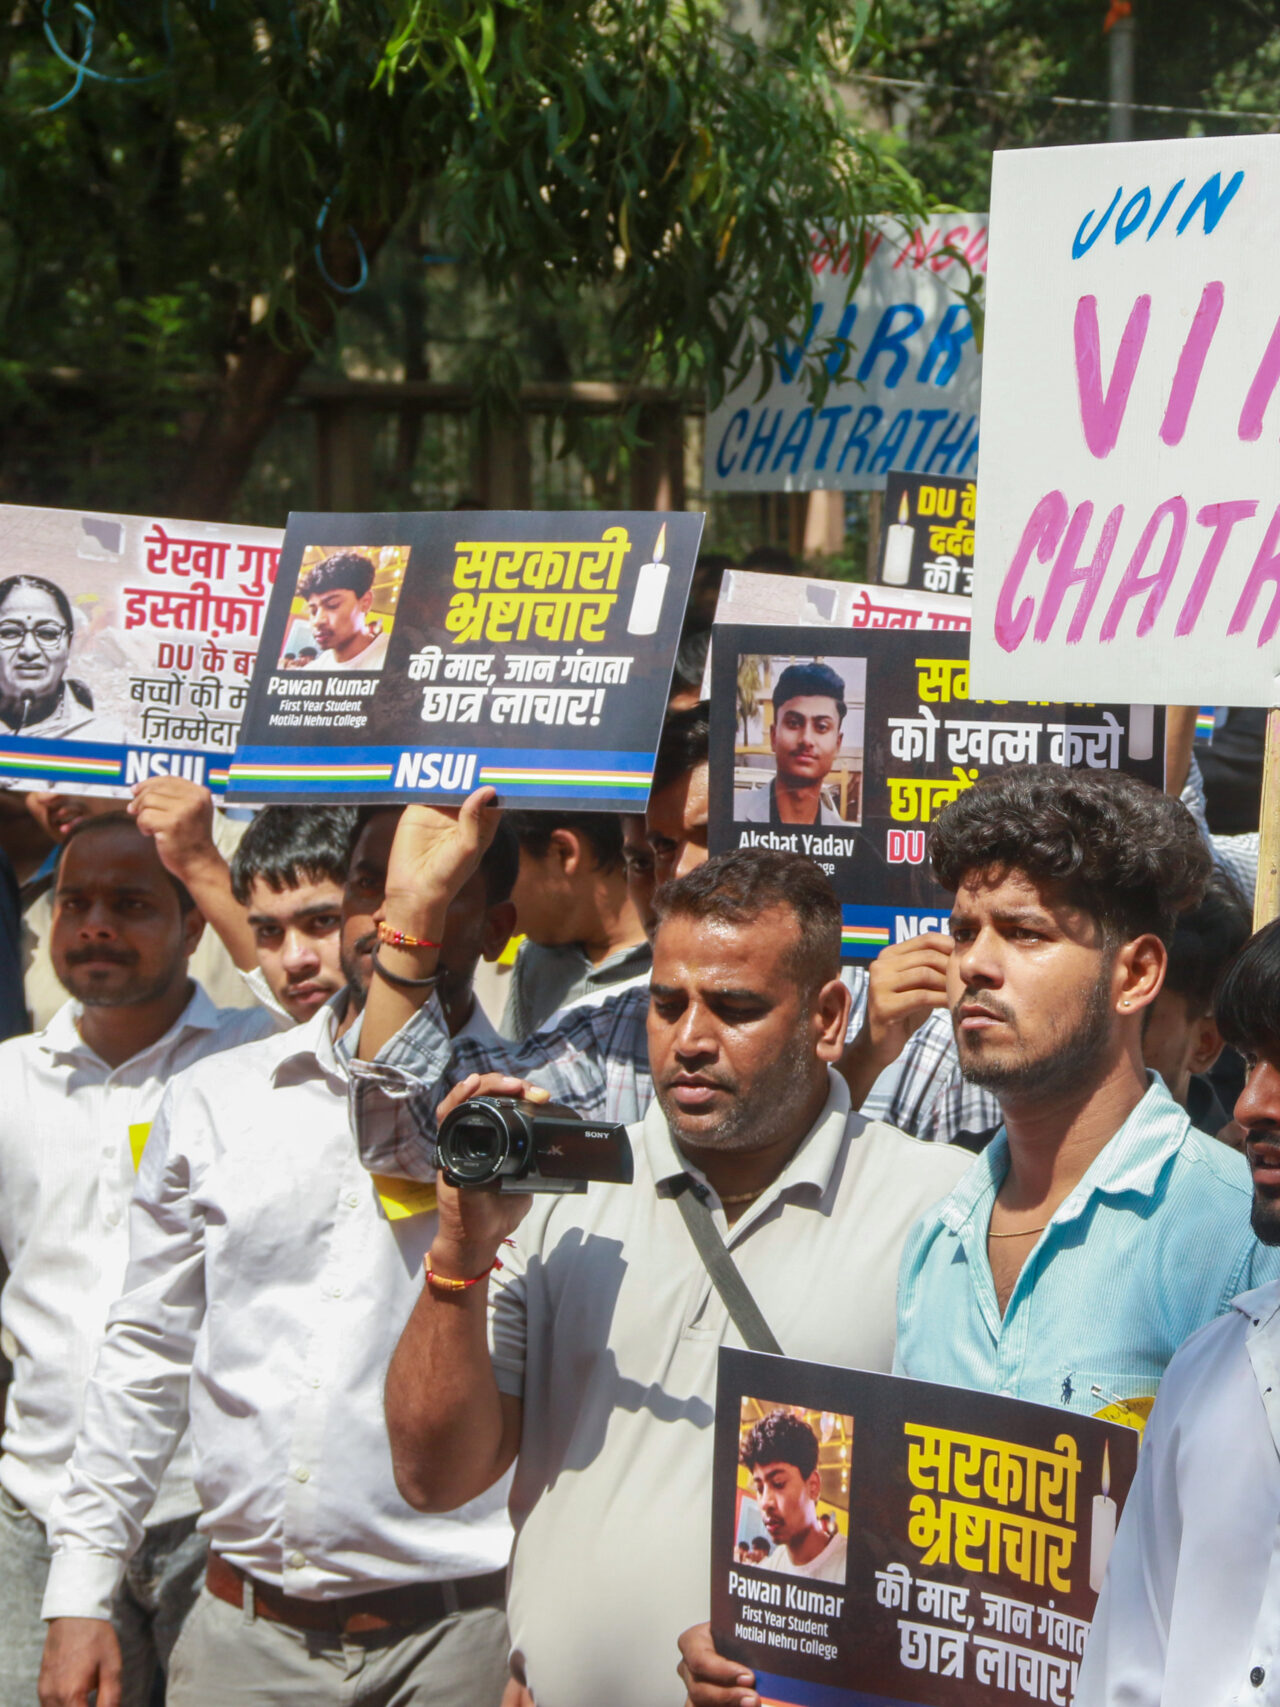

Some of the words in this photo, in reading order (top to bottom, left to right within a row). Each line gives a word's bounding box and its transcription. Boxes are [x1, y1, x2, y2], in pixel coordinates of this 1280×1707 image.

[1072, 170, 1245, 260] JOIN
[917, 485, 957, 518] DU
[144, 524, 231, 580] रेखा
[452, 526, 632, 591] सरकारी
[923, 556, 960, 594] की
[445, 592, 618, 644] भ्रष्टाचार
[158, 643, 195, 669] DU
[202, 640, 228, 674] के
[408, 645, 444, 681] की
[443, 653, 497, 687] मार,
[504, 654, 561, 684] जान
[561, 648, 635, 684] गंवाता
[129, 673, 187, 706] बच्चों
[189, 675, 224, 710] की
[267, 677, 322, 695] Pawan
[325, 678, 380, 696] Kumar
[279, 699, 302, 712] First
[303, 700, 324, 712] Year
[325, 700, 362, 712] Student
[269, 714, 302, 727] Motilal
[303, 714, 332, 727] Nehru
[333, 715, 368, 728] College
[420, 686, 489, 723] छात्र
[490, 687, 606, 727] लाचार!
[141, 706, 241, 747] ज़िम्मेदा
[888, 705, 940, 762] को
[944, 719, 1043, 765] खत्म
[1047, 711, 1124, 770] करो
[126, 751, 205, 784] NSUI
[394, 752, 477, 790] NSUI
[739, 830, 798, 853] Akshat
[802, 834, 854, 857] Yadav
[887, 829, 925, 864] DU
[584, 1131, 609, 1139] SONY
[904, 1422, 1081, 1523] सरकारी
[908, 1494, 1077, 1593] भ्रष्टाचार
[728, 1571, 781, 1606] Pawan
[785, 1584, 844, 1618] Kumar
[875, 1562, 913, 1611] की
[915, 1578, 975, 1631] मार,
[980, 1591, 1034, 1639] जान
[742, 1605, 762, 1624] First
[764, 1610, 786, 1628] Year
[788, 1616, 829, 1637] Student
[735, 1623, 766, 1644] Motilal
[768, 1631, 798, 1651] Nehru
[800, 1638, 838, 1660] College
[897, 1619, 969, 1679] छात्र
